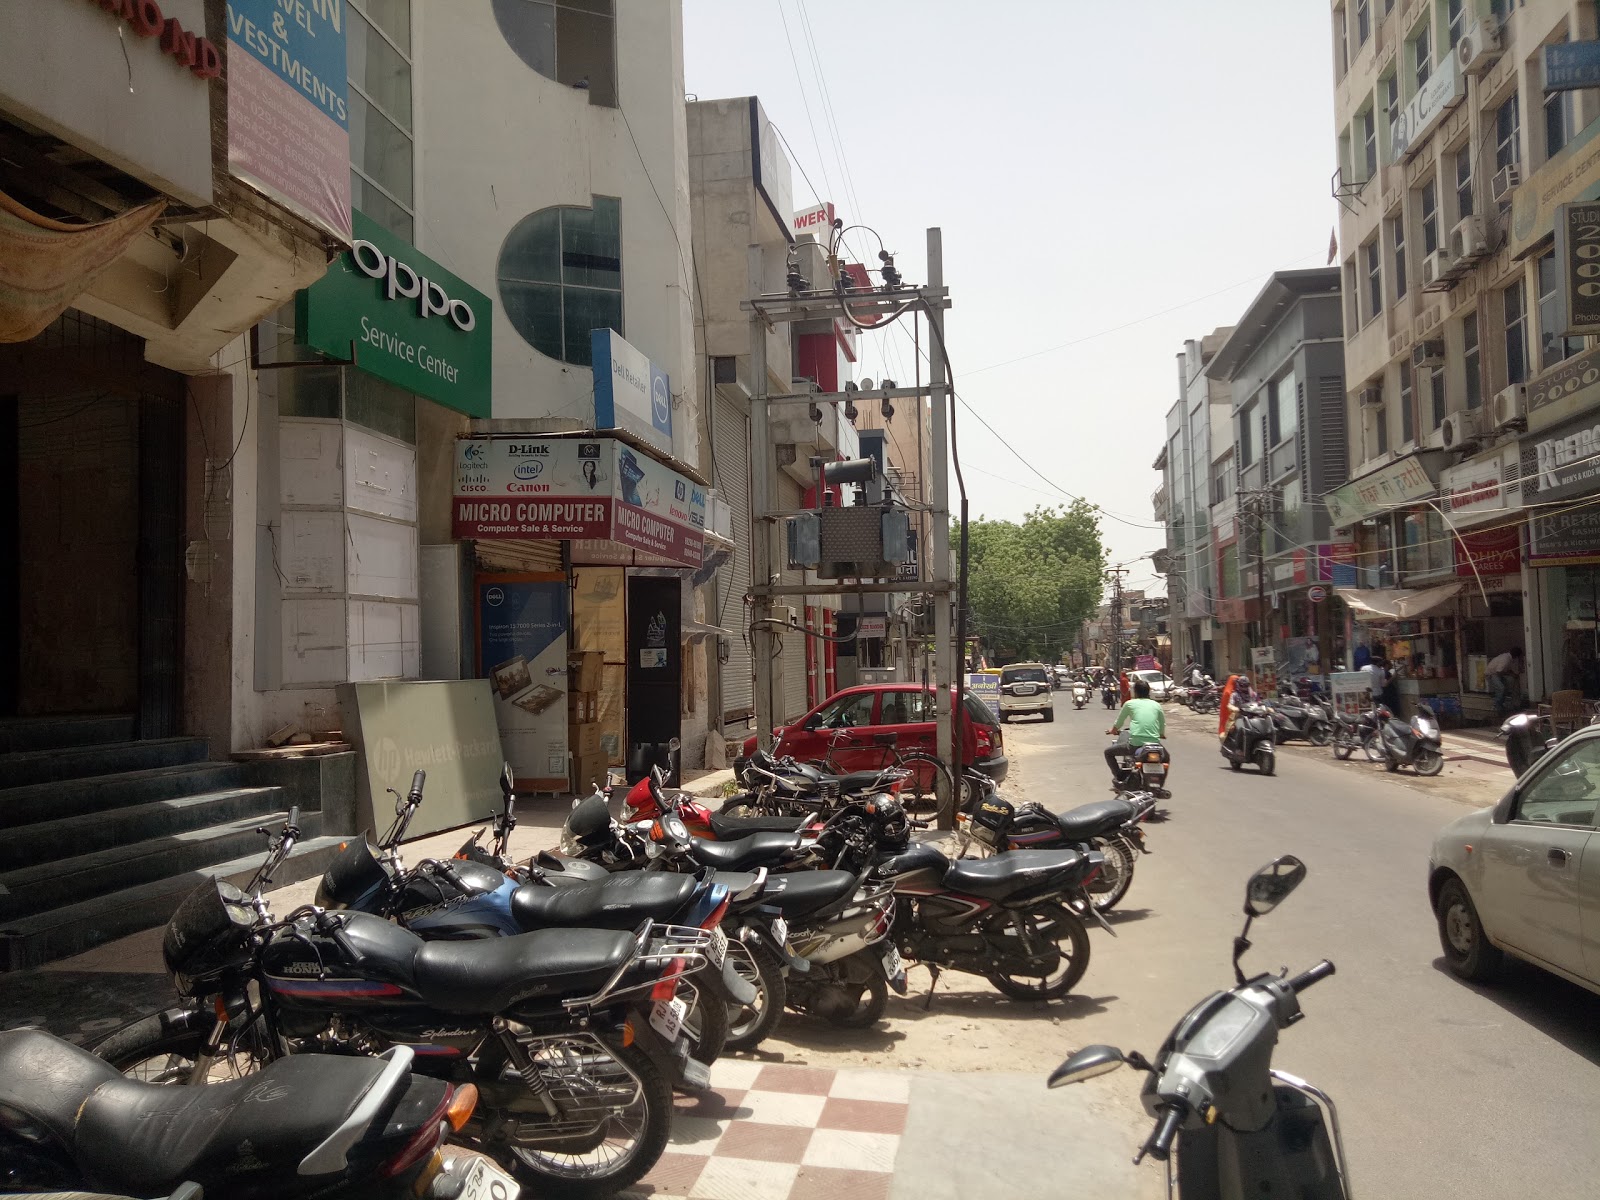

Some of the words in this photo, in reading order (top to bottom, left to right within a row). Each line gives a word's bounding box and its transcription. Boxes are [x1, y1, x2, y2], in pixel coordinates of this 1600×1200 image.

[272, 11, 289, 45] &
[352, 239, 476, 332] oppo
[361, 316, 414, 364] Service
[417, 344, 459, 385] Center
[612, 359, 625, 379] Dell
[1537, 360, 1590, 390] STUDIO
[1533, 367, 1599, 409] 2000
[508, 445, 550, 454] D-Link
[460, 462, 488, 470] Logitech
[517, 465, 538, 474] intel
[506, 482, 550, 492] Canon
[691, 487, 705, 509] DELL
[459, 503, 511, 522] MICRO
[516, 503, 605, 522] COMPUTER
[669, 503, 689, 521] lenovo
[477, 524, 519, 534] Computer
[520, 524, 540, 533] Sale
[542, 524, 550, 532] &
[551, 524, 584, 533] Service
[617, 506, 641, 531] MICRO
[641, 516, 675, 544] COMPUTER
[625, 530, 643, 542] Computer
[654, 540, 667, 550] Service
[284, 966, 332, 974] HONDA
